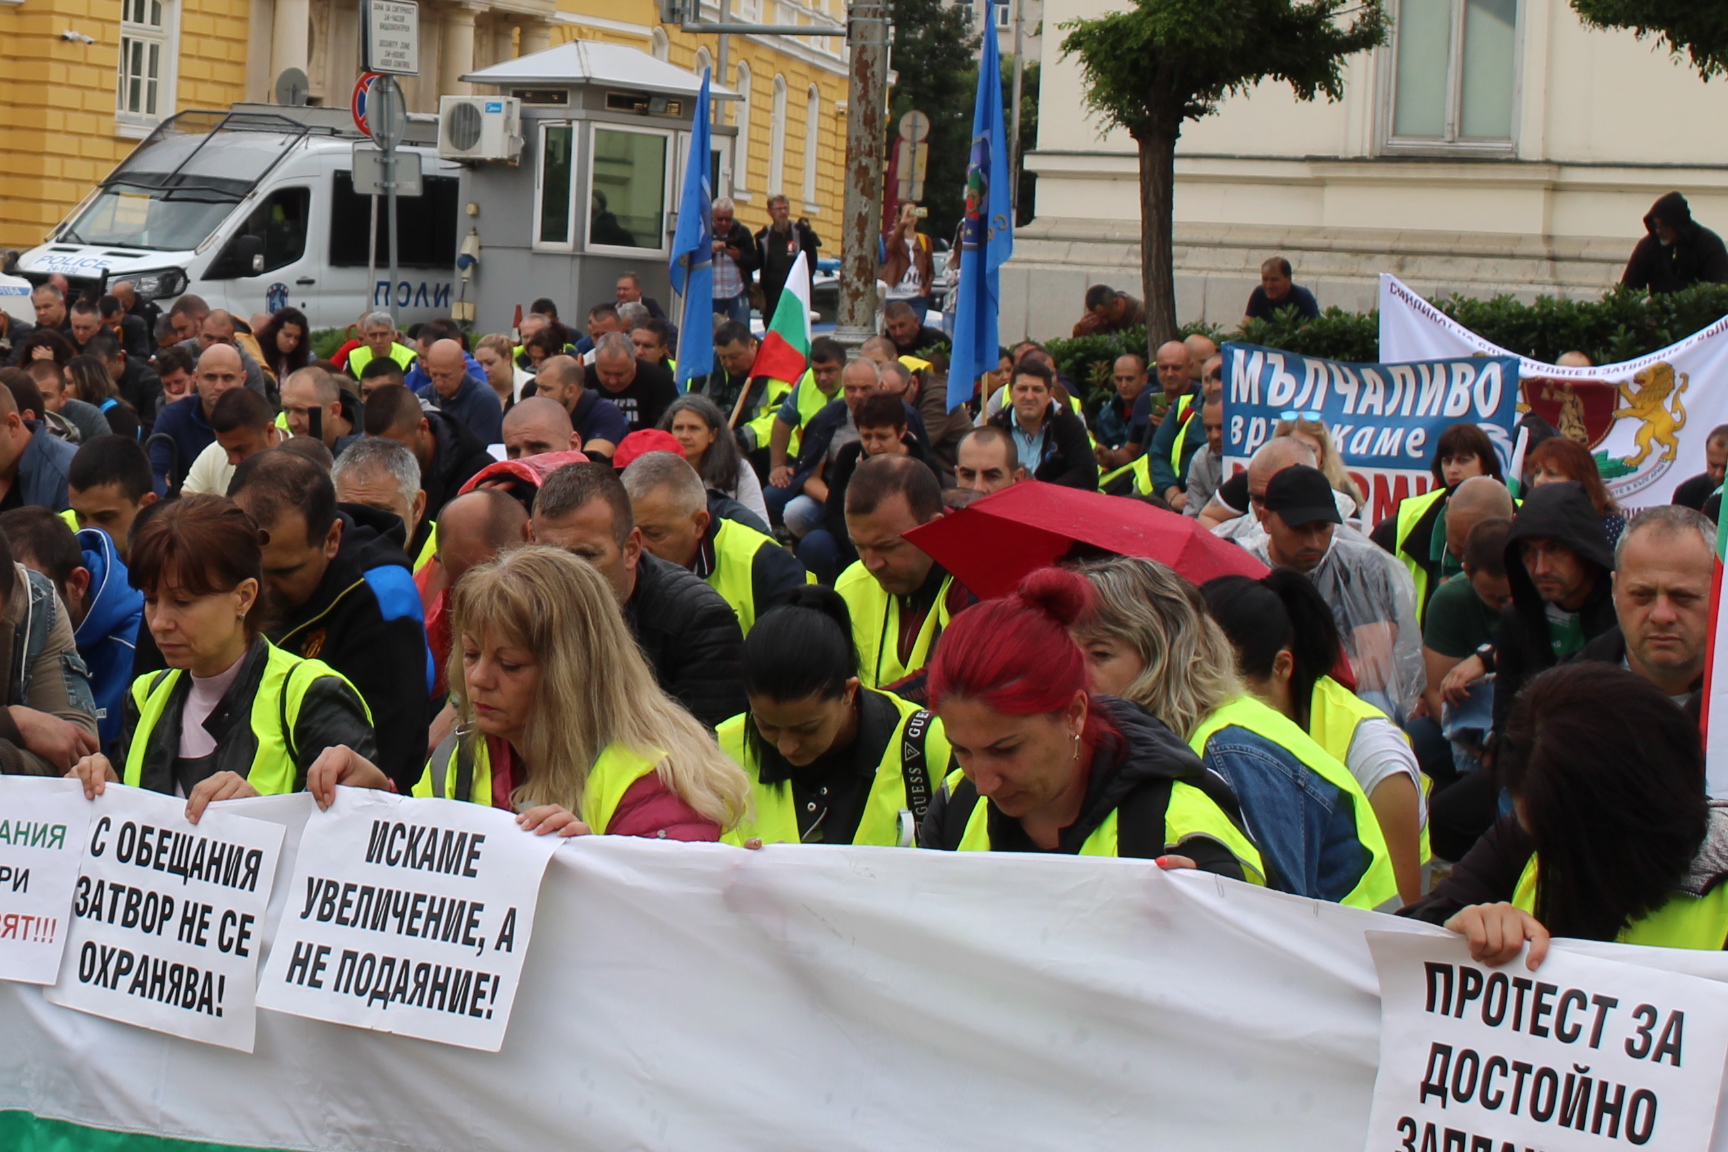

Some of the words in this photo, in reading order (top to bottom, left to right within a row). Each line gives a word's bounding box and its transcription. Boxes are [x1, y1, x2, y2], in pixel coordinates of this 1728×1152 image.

[35, 255, 112, 270] POLICE
[1230, 348, 1504, 419] МЪЛЧАЛИВО
[909, 767, 928, 815] GUESS
[89, 815, 110, 858] С
[115, 824, 264, 894] ОБЕЩАНИЯ
[365, 819, 485, 879] ИСКАМЕ
[73, 875, 174, 940] ЗАТВОР
[178, 902, 212, 948] НЕ
[218, 909, 255, 958] СЕ
[300, 876, 485, 958] УВЕЛИЧЕНИЕ,
[494, 906, 518, 953] А
[78, 940, 226, 1018] ОХРАНЯВА!
[285, 940, 331, 989] НЕ
[334, 951, 501, 1020] ПОДАЯНИЕ!
[1423, 960, 1619, 1049] ПРОТЕСТ
[1624, 1003, 1685, 1067] ЗА
[1419, 1041, 1658, 1146] ДОСТОЙНО
